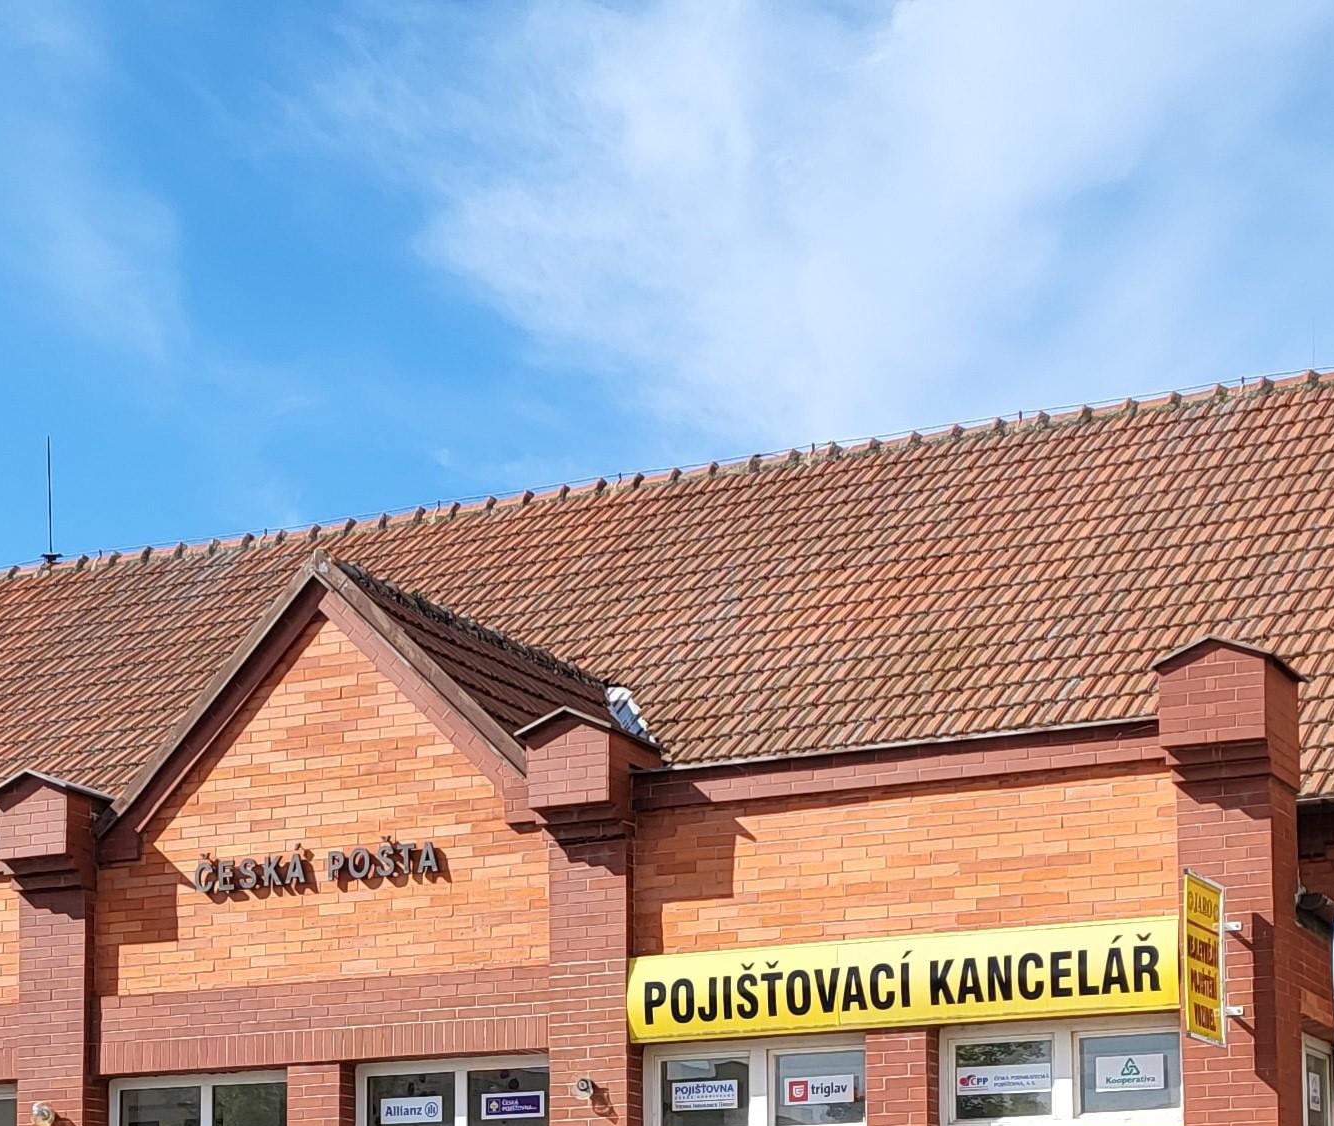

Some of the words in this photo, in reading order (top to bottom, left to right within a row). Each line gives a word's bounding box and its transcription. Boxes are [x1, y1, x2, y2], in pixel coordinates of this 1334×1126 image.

[195, 843, 305, 893] ČESKÁ
[327, 835, 439, 882] POŠTA
[1193, 892, 1213, 919] JARO
[644, 950, 913, 1025] POJIŠŤOVACÍ
[929, 933, 1162, 1006] KANCELÁŘ
[1190, 967, 1218, 1001] POJIŠTĚNÍ
[1193, 1001, 1217, 1032] VOZIDEL
[675, 1083, 734, 1097] POJIŠŤOVNA
[811, 1081, 848, 1098] triglav
[1105, 1075, 1156, 1085] Kooperativa
[385, 1104, 423, 1117] Allianz
